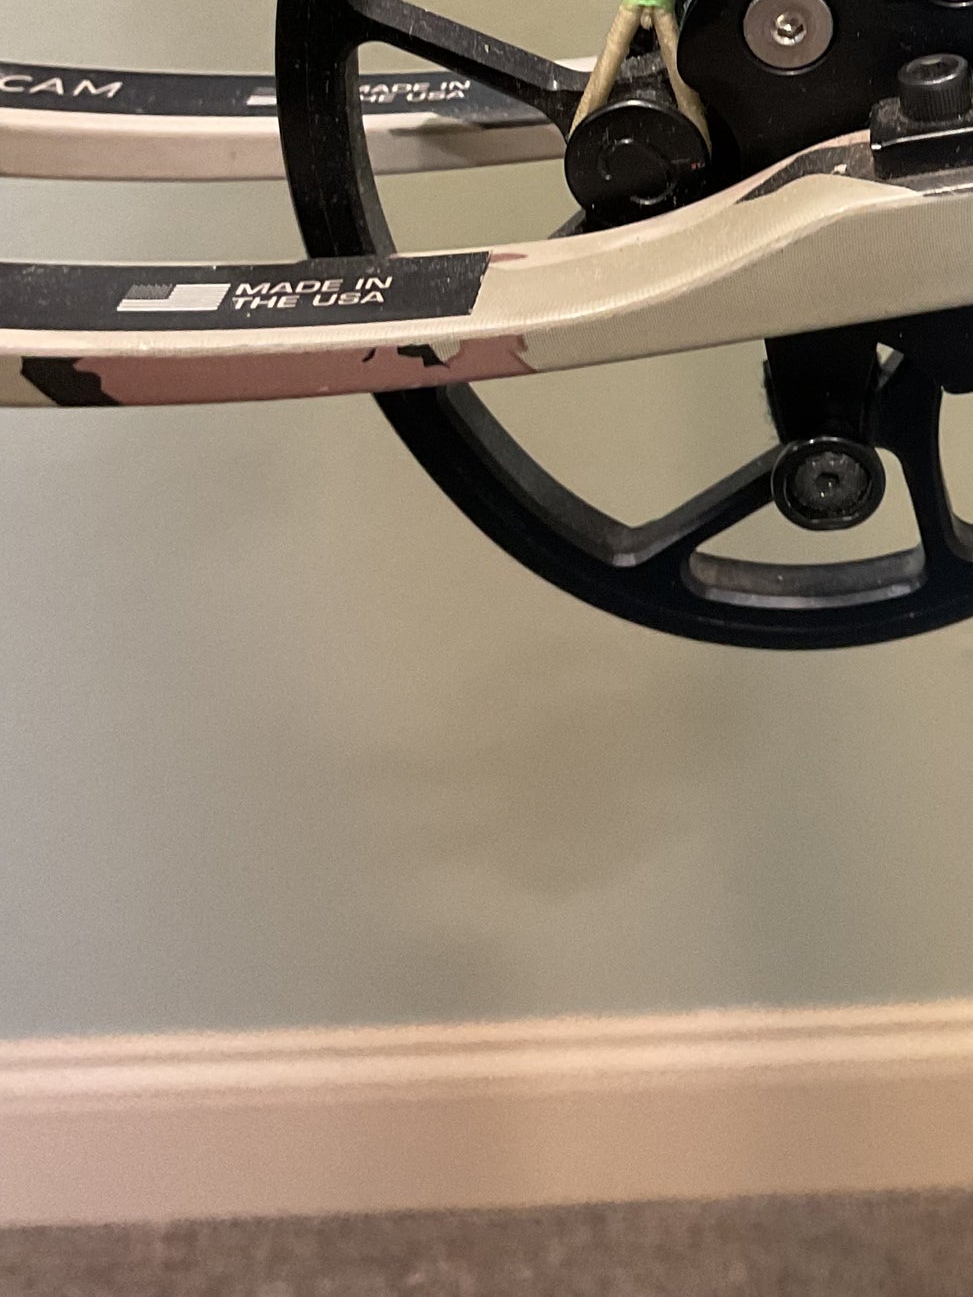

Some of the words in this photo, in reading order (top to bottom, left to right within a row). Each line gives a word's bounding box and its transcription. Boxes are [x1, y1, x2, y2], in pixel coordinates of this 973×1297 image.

[0, 74, 123, 98] CAM
[440, 80, 470, 90] IN
[235, 278, 344, 296] MADE
[355, 276, 393, 291] IN
[232, 294, 300, 310] THE
[312, 291, 385, 307] USA
